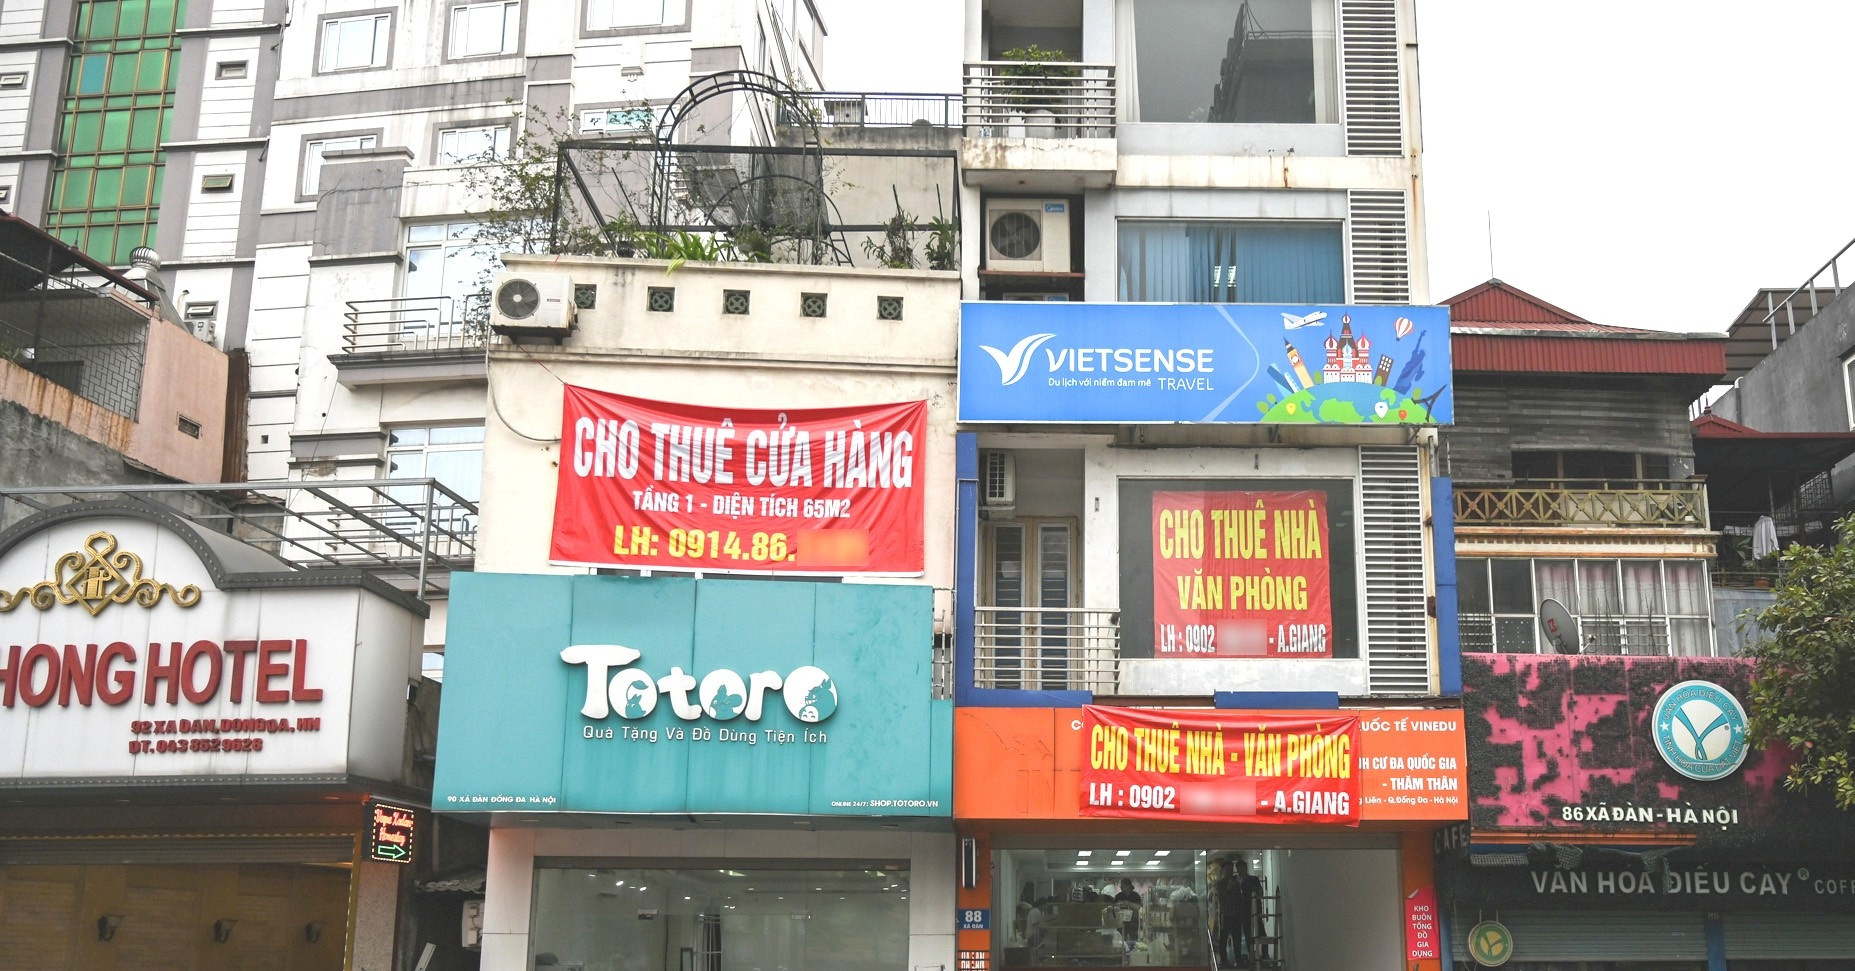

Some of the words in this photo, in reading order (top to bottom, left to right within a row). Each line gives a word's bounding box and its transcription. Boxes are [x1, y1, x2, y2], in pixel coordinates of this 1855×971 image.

[1046, 348, 1215, 373] VIETSENSE
[1048, 378, 1061, 387] Du
[1062, 377, 1078, 388] lịch
[1117, 377, 1136, 387] đam
[1138, 378, 1152, 387] mê
[1158, 377, 1215, 391] TRAVEL
[574, 416, 641, 480] CHO
[651, 417, 736, 485] THUÊ
[746, 412, 813, 487] CỬA
[823, 419, 913, 489] HÀNG
[633, 484, 679, 513] TẦNG
[685, 494, 694, 513] 1
[713, 491, 754, 519] DIỆN
[759, 493, 799, 518] TÍCH
[803, 498, 851, 518] 65M2
[613, 525, 660, 556] LH:
[1159, 508, 1205, 560] CHO
[1210, 498, 1268, 560] THUÊ
[1273, 498, 1323, 560] NHÀ
[1176, 567, 1223, 610] VĂN
[1229, 567, 1308, 611] PHÒNG
[1160, 624, 1175, 653] LH
[1185, 624, 1216, 653] 0902
[1276, 623, 1326, 653] A.GIANG
[143, 638, 324, 706] HOTEL
[559, 644, 838, 724] Totoro
[131, 720, 153, 734] 92
[153, 720, 177, 734] XA
[621, 726, 658, 742] Tặng
[666, 727, 684, 740] Và
[692, 724, 711, 741] Đồ
[719, 728, 757, 745] Dùng
[765, 728, 795, 745] Tiện
[804, 727, 828, 743] Ích
[1359, 717, 1391, 732] UỐC
[1393, 717, 1408, 731] TẾ
[1411, 721, 1456, 732] VINEDU
[156, 739, 189, 754] 043
[1090, 724, 1129, 771] CHO
[1133, 720, 1180, 773] THUÊ
[1186, 722, 1225, 775] NHÀ
[1243, 723, 1282, 777] VĂN
[1286, 723, 1350, 779] PHÒNG
[1407, 752, 1436, 771] QUỐC
[1438, 757, 1457, 770] GIA
[1390, 775, 1424, 791] THĂM
[1426, 775, 1458, 791] THÂN
[490, 794, 514, 803] ĐỐNG
[529, 795, 540, 803] HÀ
[542, 795, 556, 805] NỘI
[870, 799, 938, 808] SHOP.TOTORO.VN
[1089, 782, 1113, 806] LH
[1129, 784, 1176, 809] 0902
[1273, 790, 1350, 815] A.GIANG
[1562, 806, 1584, 821] 86
[1586, 802, 1610, 821] XÃ
[1612, 802, 1654, 822] ĐÀN
[1666, 802, 1698, 824] HÀ
[1702, 806, 1738, 830] NỘI
[1740, 864, 1792, 895] CÀY
[965, 910, 982, 922] 88
[1412, 950, 1433, 958] DỤNG
